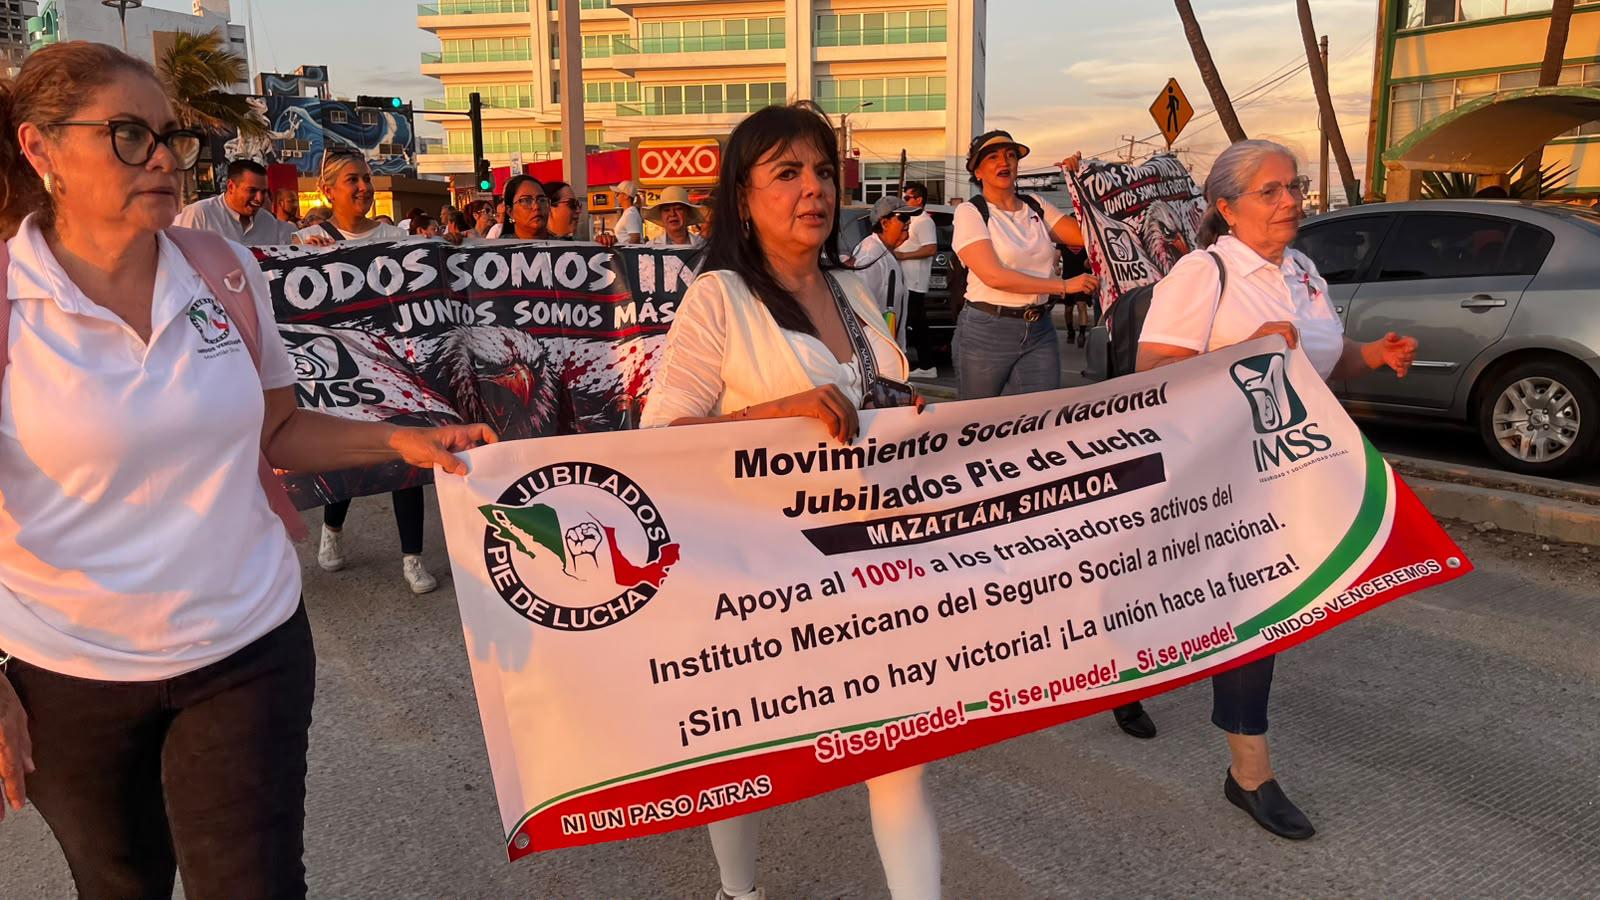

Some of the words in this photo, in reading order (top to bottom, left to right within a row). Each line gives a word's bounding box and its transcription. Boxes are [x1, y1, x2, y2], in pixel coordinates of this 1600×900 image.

[641, 146, 717, 178] OXXO
[1103, 189, 1137, 216] JUNTOS
[446, 252, 617, 292] SOMOS
[1115, 262, 1147, 281] IMSS
[393, 299, 497, 333] JUNTOS
[514, 301, 603, 327] SOMOS
[614, 297, 675, 329] MÁS
[297, 378, 386, 408] MSS
[860, 348, 874, 385] NAUTICA
[734, 430, 948, 479] Movimiento
[958, 410, 1052, 447] Social
[1054, 382, 1169, 427] Nacional
[1252, 422, 1332, 473] IMSS
[783, 473, 963, 518] Jubilados
[965, 458, 1021, 488] Pie
[1026, 448, 1067, 472] de
[1067, 427, 1162, 460] Lucha
[515, 465, 666, 542] JUBILADOS
[866, 500, 1012, 545] MAZATLÁN,
[1018, 472, 1118, 514] SINALOA
[714, 582, 813, 621] Apoya
[821, 571, 846, 597] al
[851, 558, 926, 589] 100%
[930, 558, 948, 573] a
[949, 550, 992, 569] los
[994, 511, 1145, 561] trabajadores
[1150, 496, 1208, 524] activos
[1212, 484, 1233, 508] del
[487, 545, 518, 592] PIE
[510, 587, 550, 622] DE
[552, 590, 648, 628] LUCHA
[649, 637, 783, 685] Instituto
[791, 604, 929, 652] Mexicano
[937, 587, 978, 618] del
[984, 570, 1073, 605] Seguro
[1079, 548, 1142, 584] Social
[1147, 551, 1158, 567] a
[1162, 532, 1201, 563] nivel
[1204, 512, 1287, 551] naciónal.
[1261, 606, 1326, 642] UNIDOS
[1325, 560, 1441, 612] VENCEREMOS
[679, 706, 742, 747] ¡Sin
[751, 686, 835, 722] lucha
[843, 674, 880, 699] no
[888, 658, 938, 687] hay
[946, 625, 1052, 672] victoria!
[1059, 618, 1098, 650] ¡La
[1103, 599, 1158, 633] unión
[1160, 587, 1206, 614] hace
[1207, 578, 1227, 600] la
[1228, 553, 1301, 593] fuerza!
[1137, 648, 1155, 671] Si
[1159, 644, 1178, 664] se
[1181, 621, 1236, 661] puede!
[988, 689, 1012, 713] Si
[1017, 685, 1042, 706] se
[1049, 659, 1118, 702] puede!
[816, 733, 843, 760] Si
[850, 730, 878, 752] se
[885, 701, 966, 748] puede!
[562, 815, 586, 833] NI
[590, 809, 624, 829] UN
[629, 797, 692, 824] PASO
[698, 777, 771, 811] ATRAS
